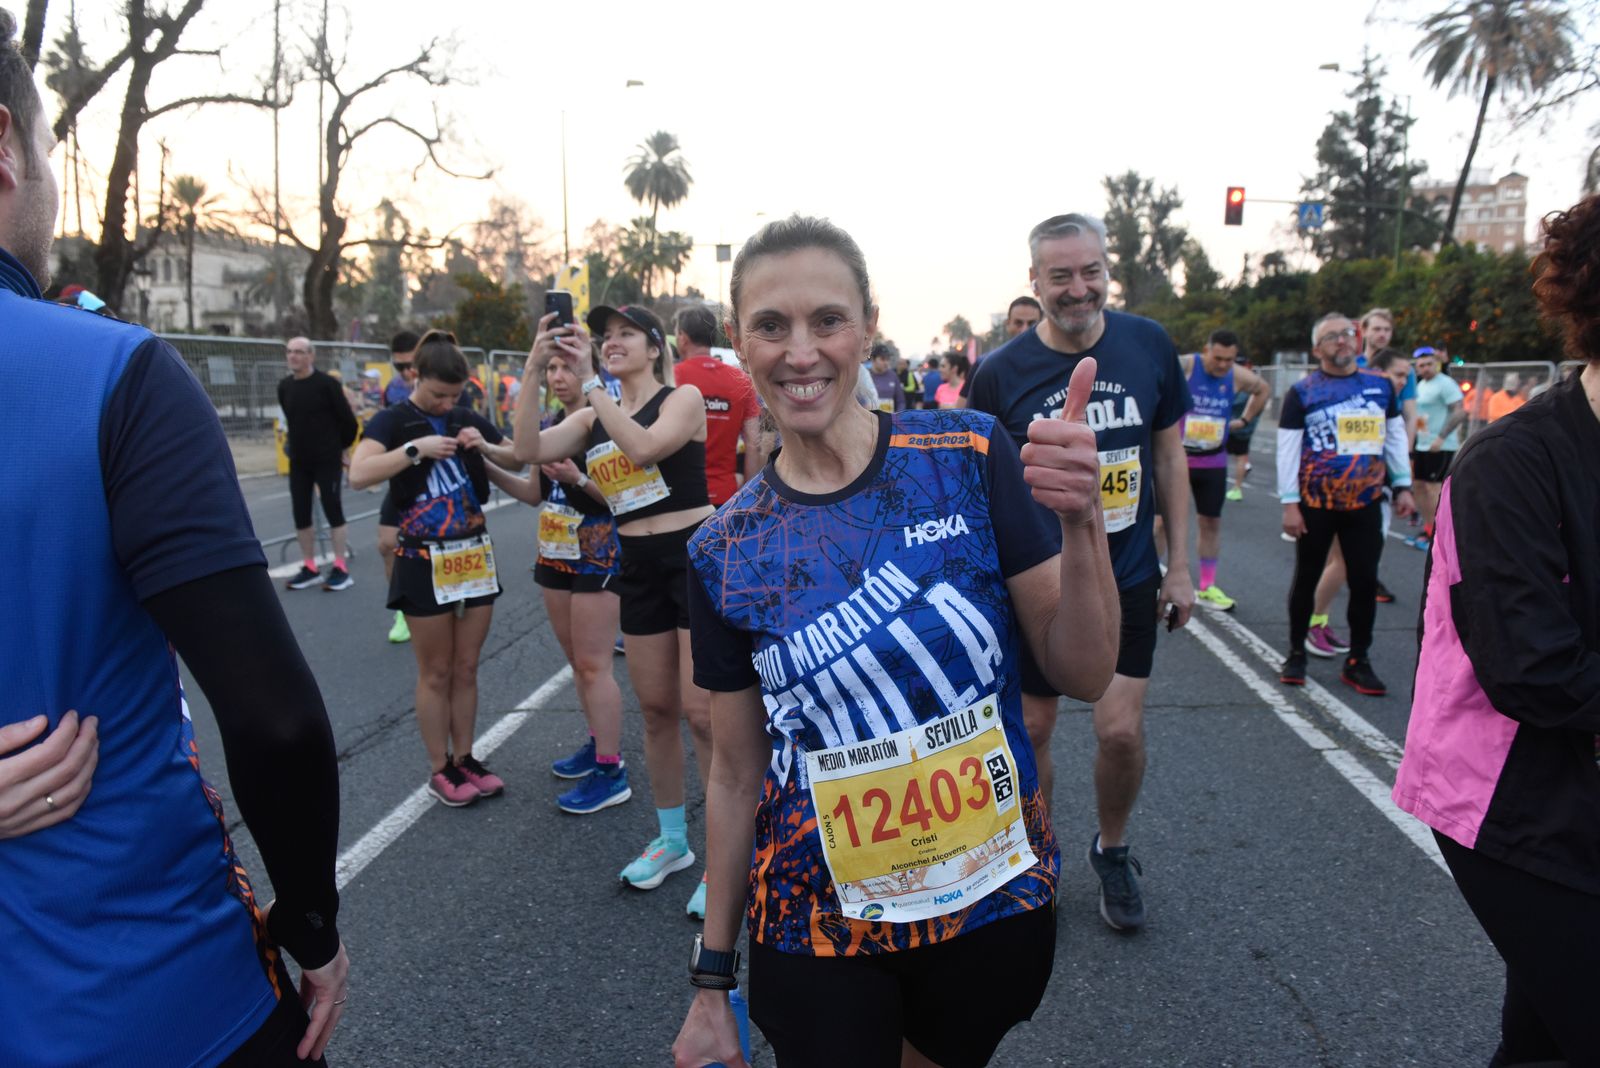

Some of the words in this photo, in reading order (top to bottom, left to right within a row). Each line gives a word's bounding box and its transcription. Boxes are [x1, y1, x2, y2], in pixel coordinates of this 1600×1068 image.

[1033, 396, 1143, 432] OLA
[1345, 420, 1376, 434] 9857
[1101, 470, 1129, 495] 45
[903, 514, 970, 548] HOKA
[443, 552, 483, 576] 9852
[783, 560, 920, 678] MARATÓN
[817, 751, 847, 772] MEDIO
[849, 738, 899, 766] MARATÓN
[924, 709, 978, 750] SEVILLA
[832, 756, 991, 849] 12403
[825, 821, 836, 849] CAJÓN
[911, 832, 938, 847] Cristi
[891, 857, 930, 872] Alconchel
[931, 844, 967, 863] Alcoverro
[933, 889, 964, 905] HOKA
